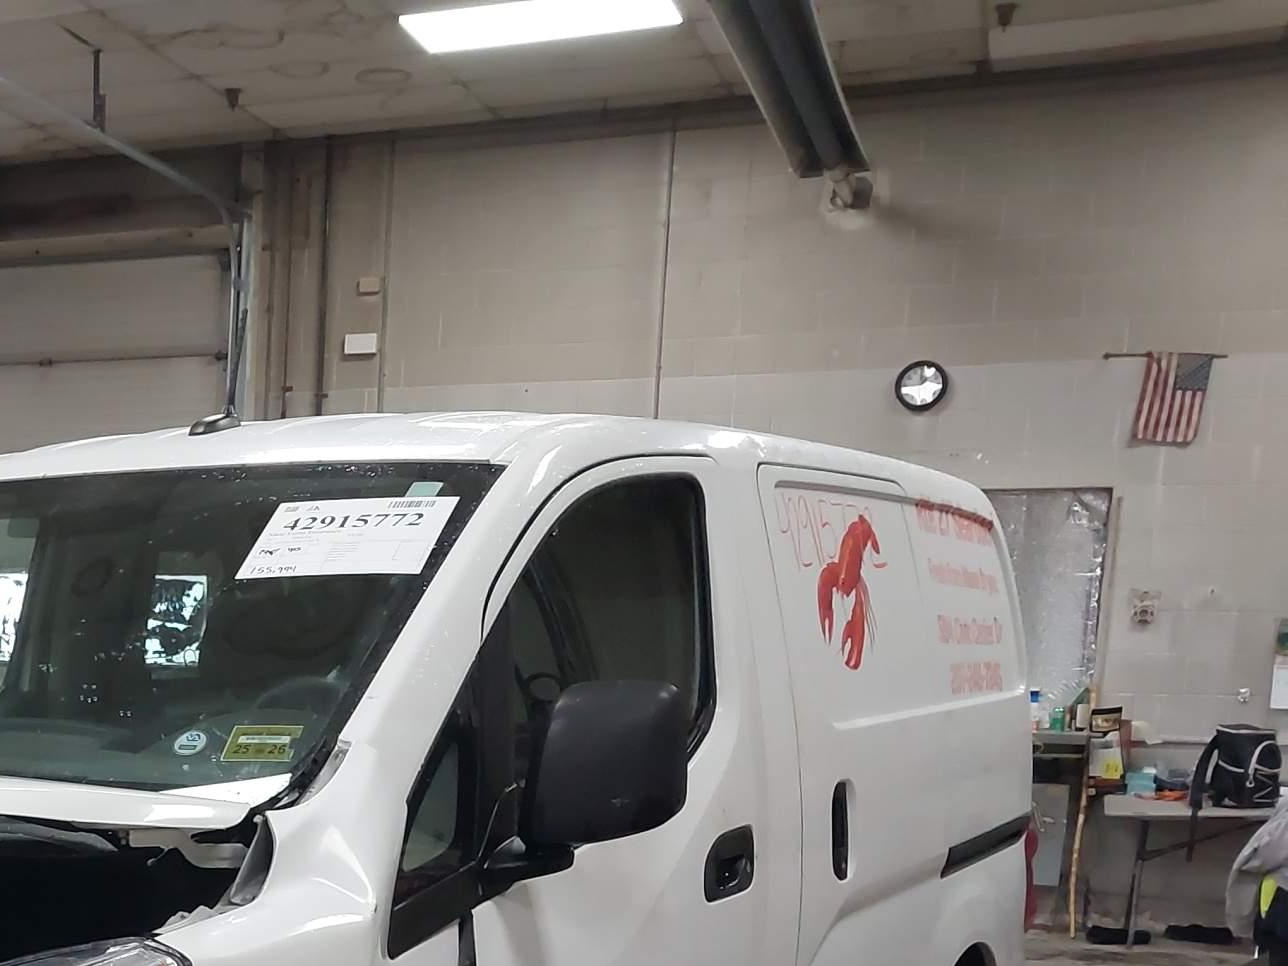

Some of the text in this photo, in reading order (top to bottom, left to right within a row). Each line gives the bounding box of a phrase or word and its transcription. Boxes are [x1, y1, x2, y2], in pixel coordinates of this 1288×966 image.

[282, 512, 425, 531] 42915772
[233, 744, 287, 754] 25 26
